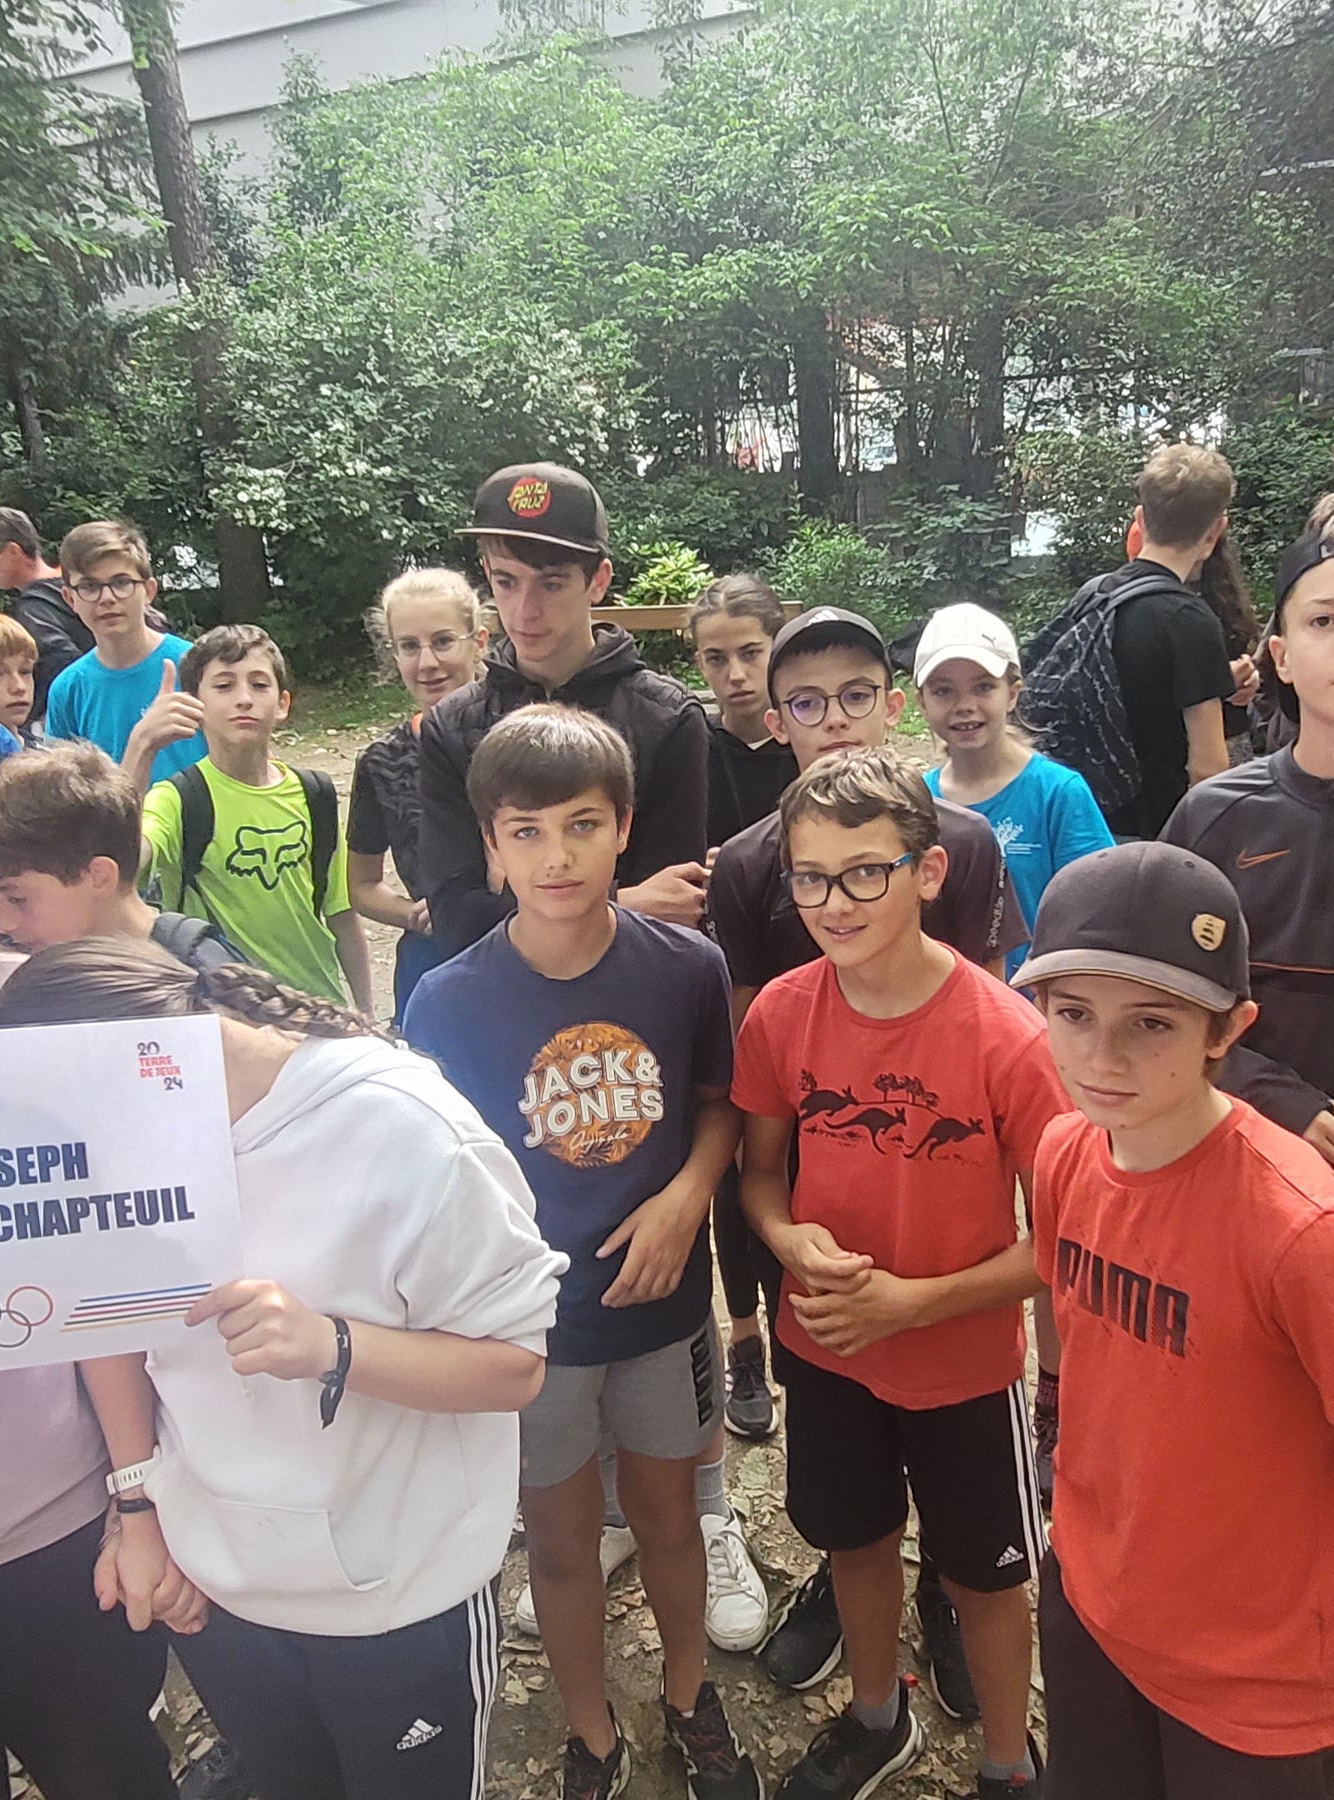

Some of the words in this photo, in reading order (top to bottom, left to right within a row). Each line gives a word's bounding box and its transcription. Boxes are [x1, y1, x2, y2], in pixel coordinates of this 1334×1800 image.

[137, 1041, 160, 1057] 20
[139, 1055, 173, 1067] TERRE
[140, 1067, 154, 1078] DE
[155, 1065, 181, 1077] JEUX
[163, 1076, 183, 1091] 24
[523, 1086, 664, 1149] JONES
[1056, 1237, 1190, 1358] PUMA
[396, 1724, 443, 1750] adidas
